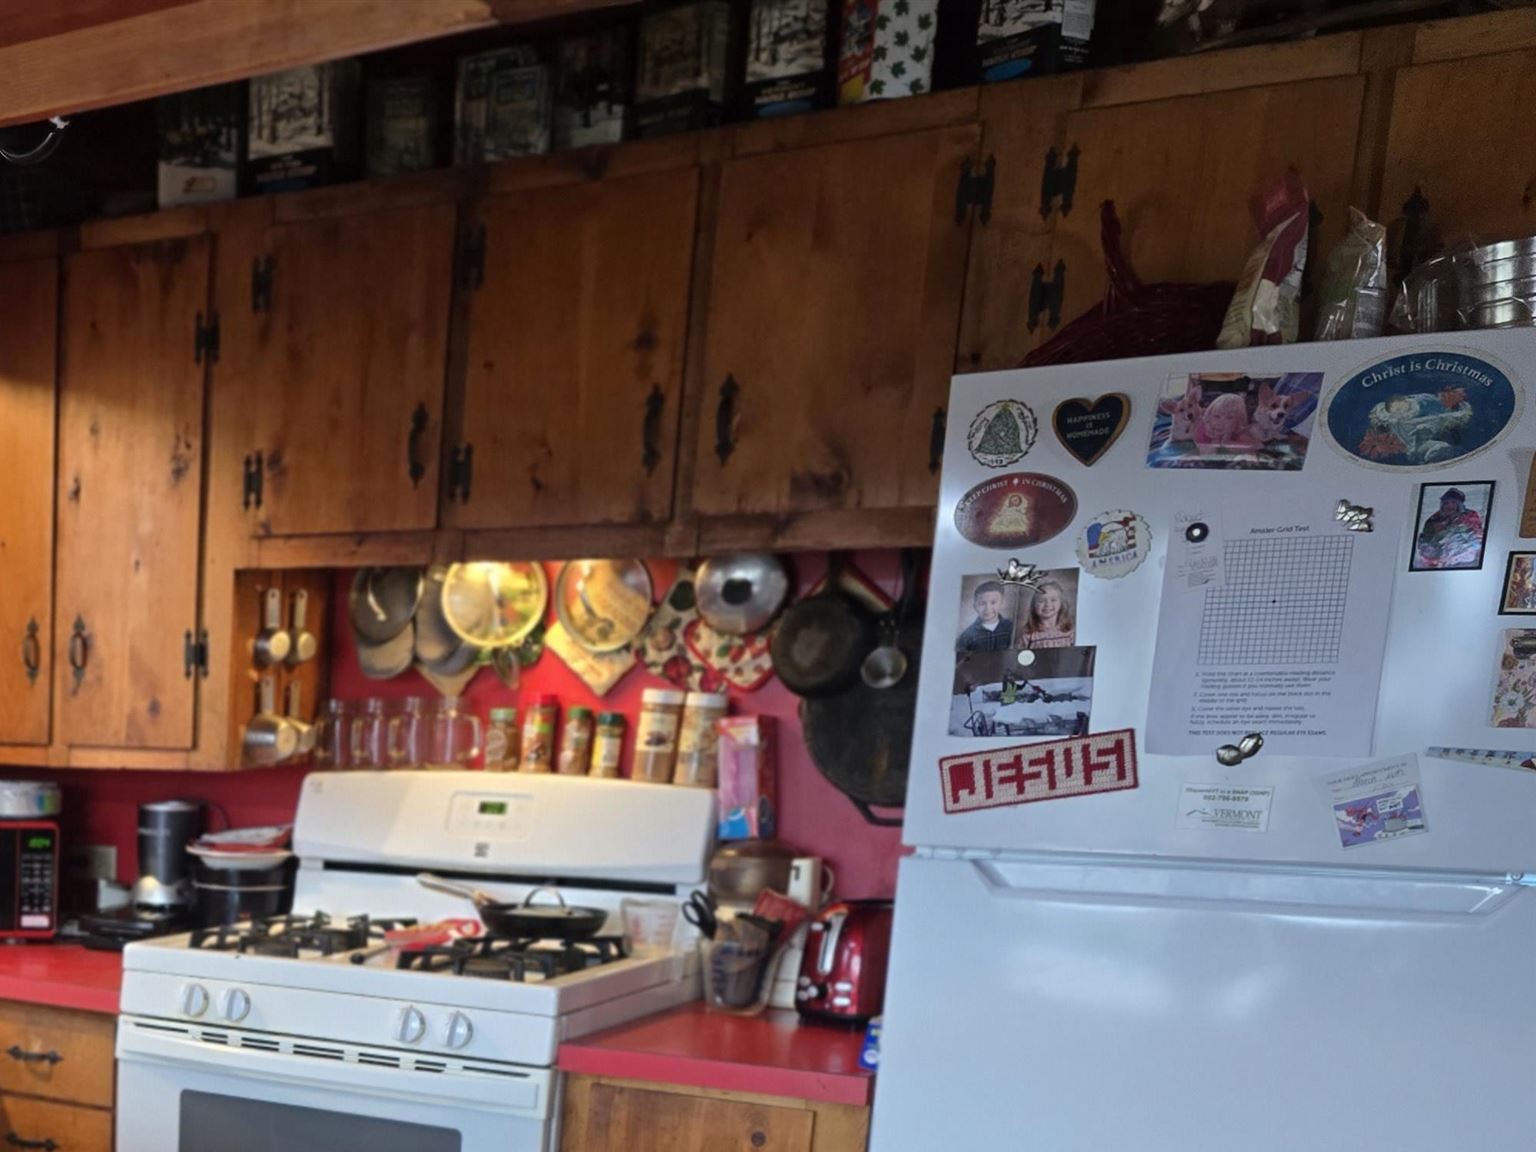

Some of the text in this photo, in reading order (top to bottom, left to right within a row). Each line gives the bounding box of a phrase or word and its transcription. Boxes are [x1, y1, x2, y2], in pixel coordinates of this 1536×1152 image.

[1361, 358, 1494, 388] Christ is Christmas
[1066, 412, 1111, 424] HAPPINESS
[1066, 427, 1110, 439] HOMEMADE
[981, 480, 1008, 494] CHRIST
[1031, 479, 1069, 504] CHRISTMAS
[1276, 525, 1293, 534] Grid
[1295, 524, 1310, 532] Test
[949, 737, 1127, 806] JESUS
[1214, 808, 1263, 820] VERMONT
